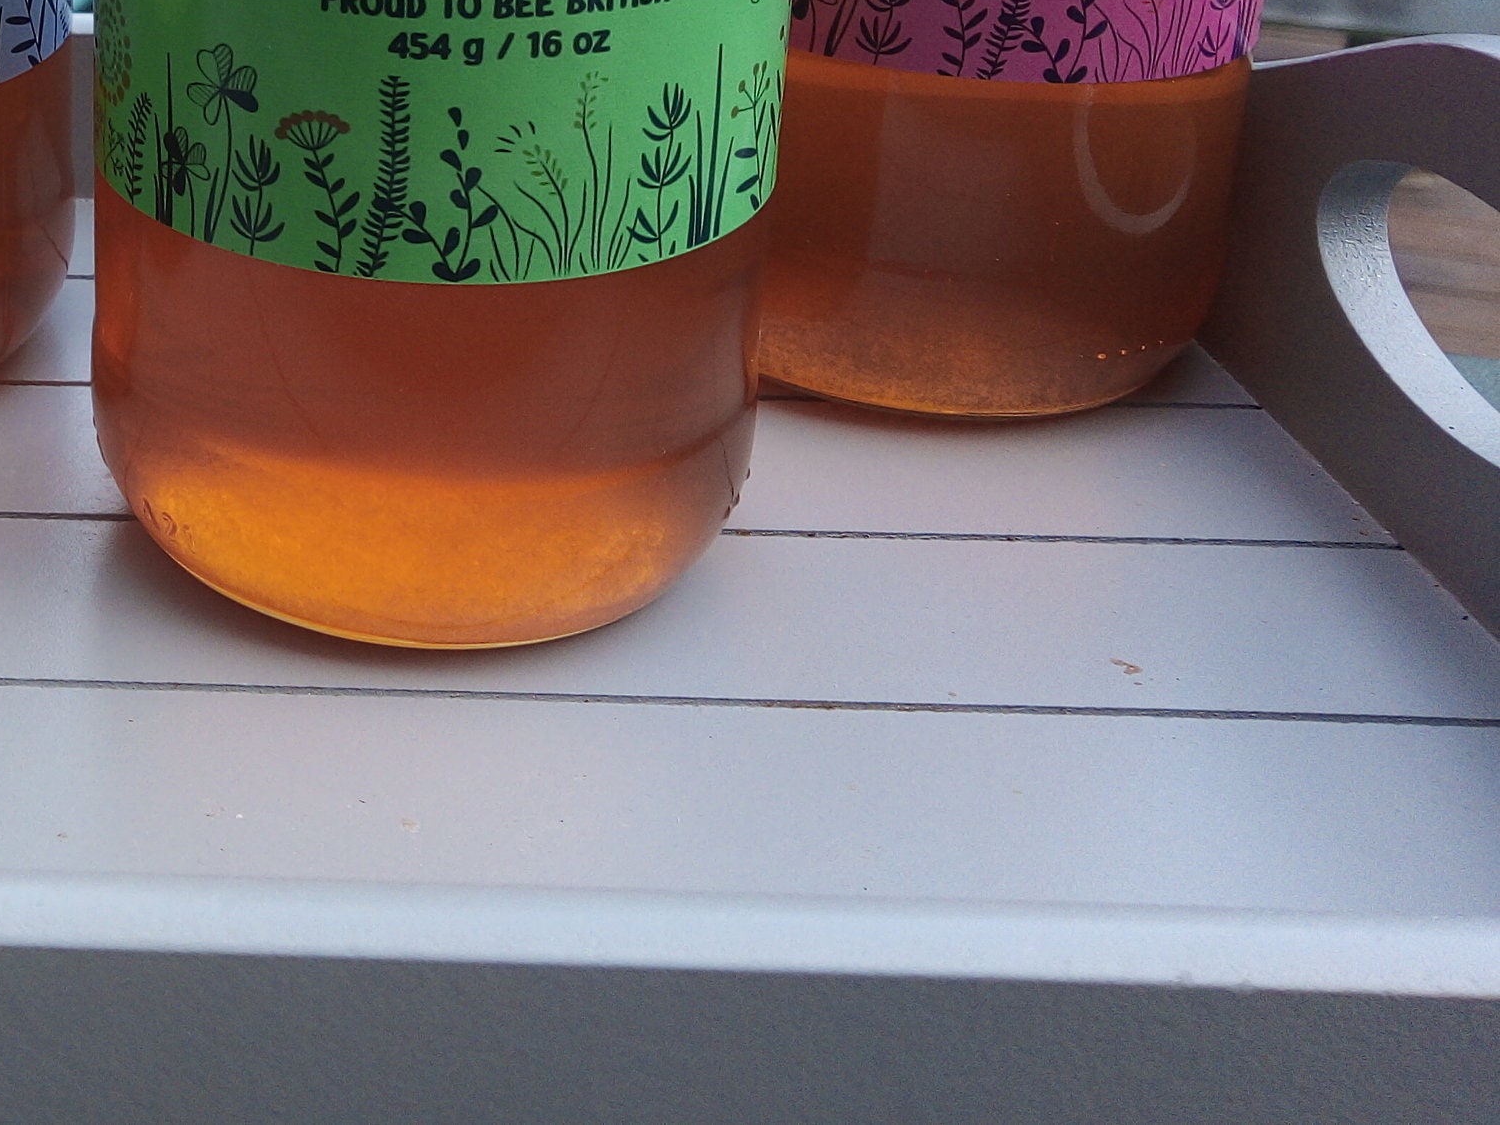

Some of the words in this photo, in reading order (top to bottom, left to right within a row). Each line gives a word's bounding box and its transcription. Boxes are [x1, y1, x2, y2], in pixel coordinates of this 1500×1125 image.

[388, 32, 452, 61] 454
[463, 38, 484, 67] g
[497, 32, 514, 60] /
[527, 30, 562, 59] 16
[573, 29, 610, 56] oz
